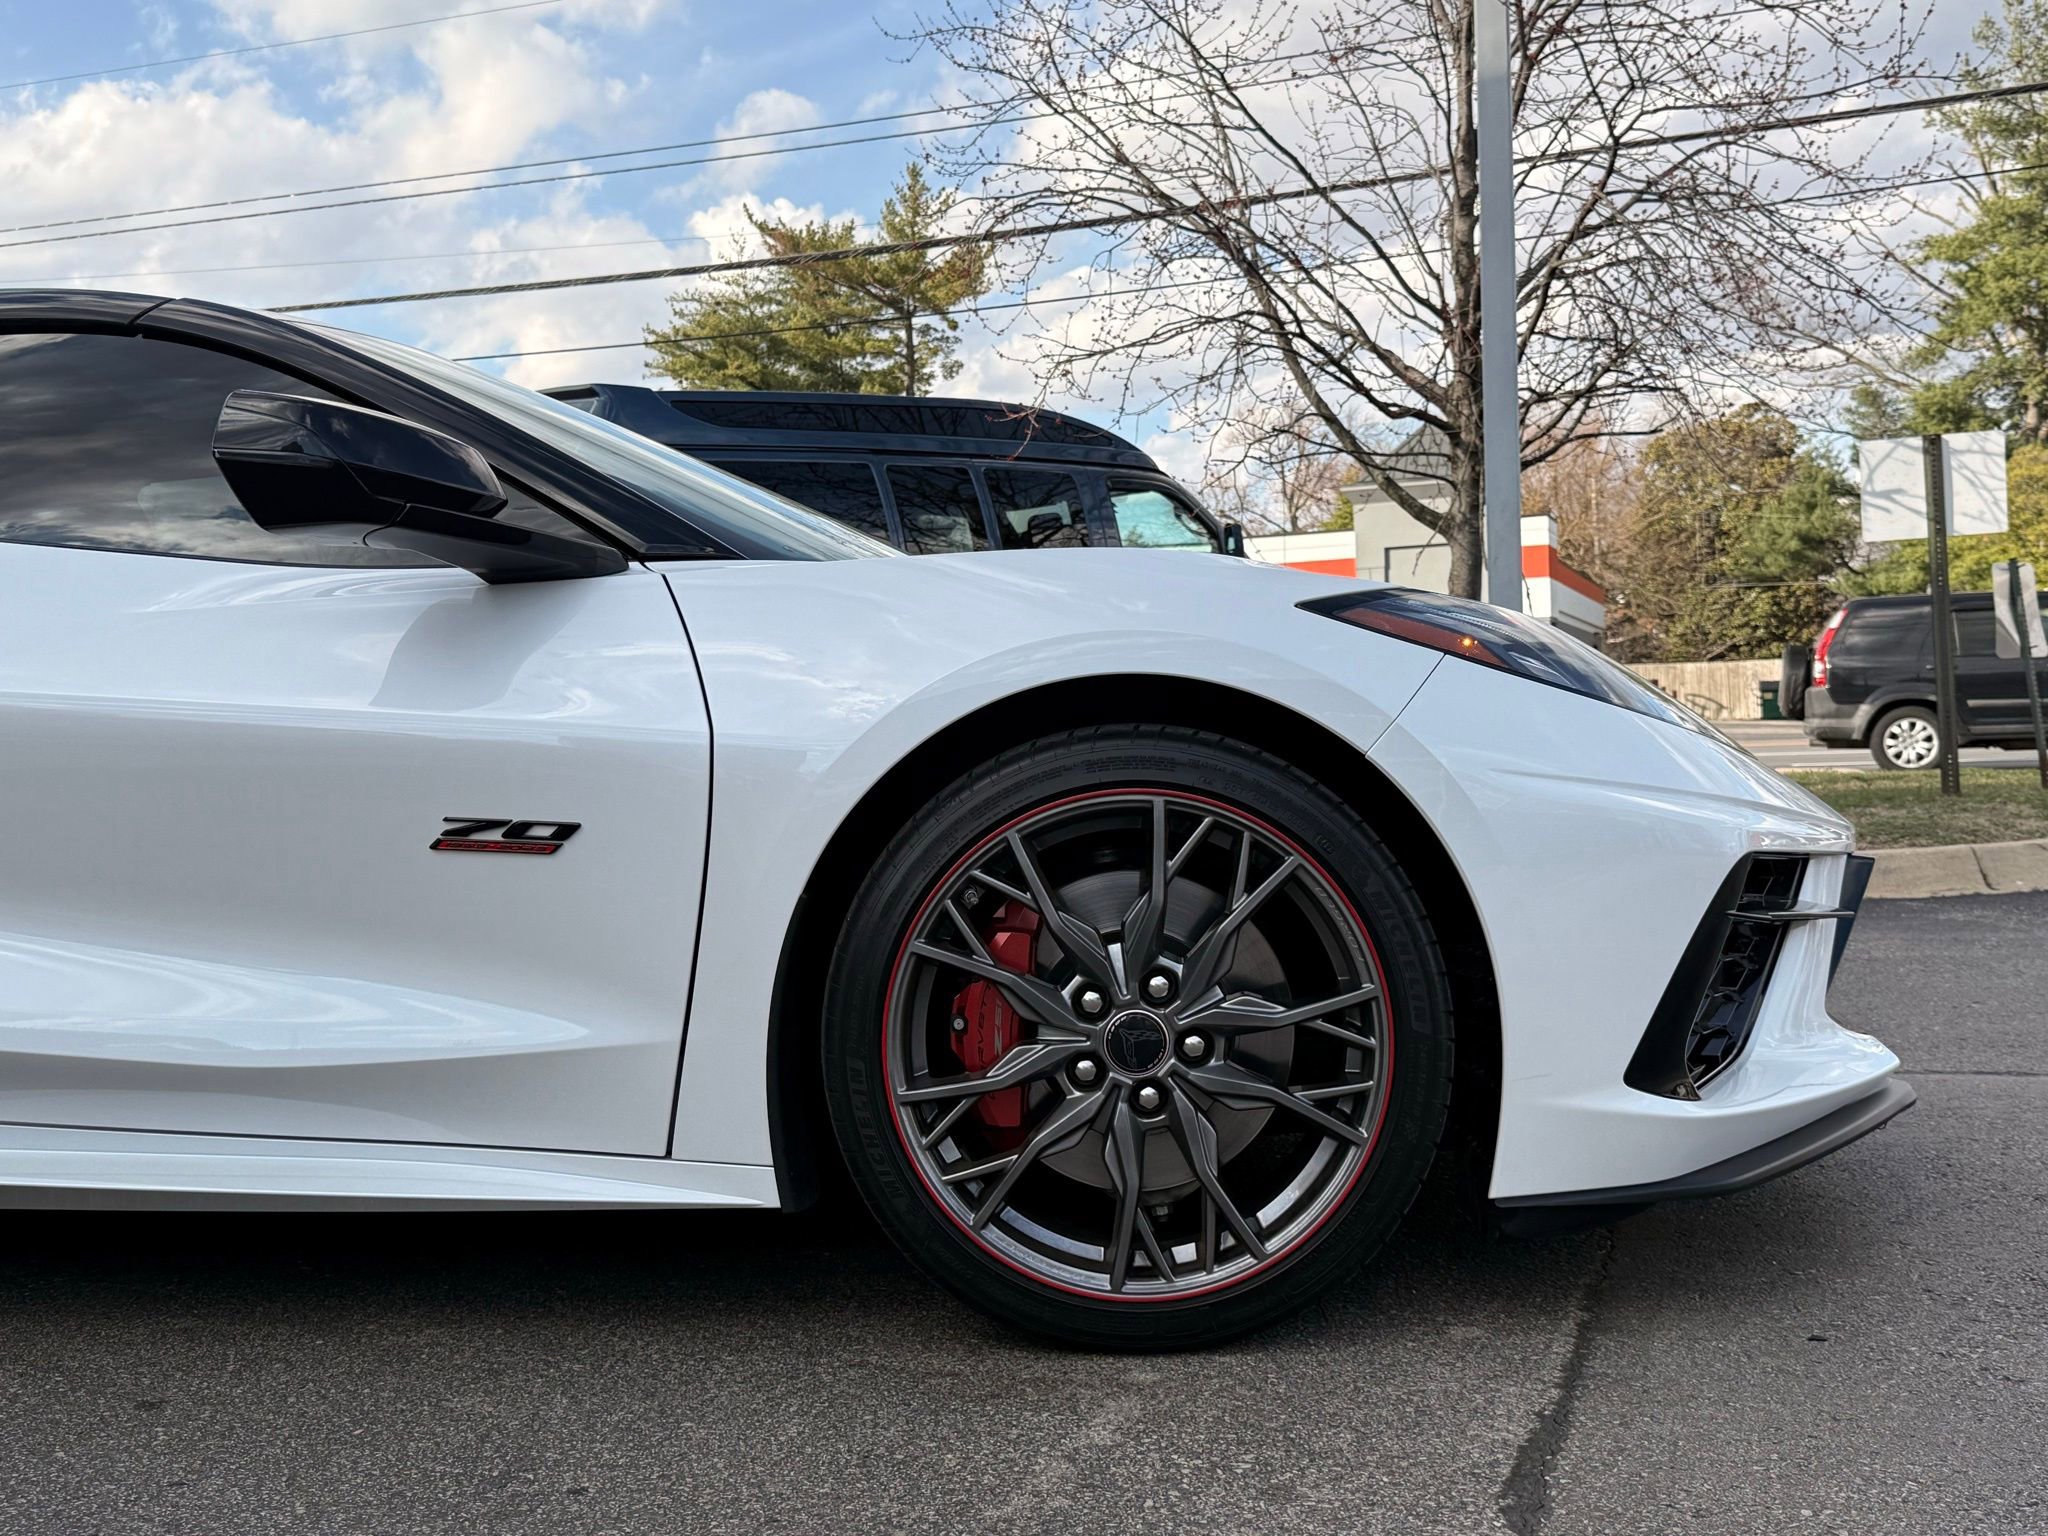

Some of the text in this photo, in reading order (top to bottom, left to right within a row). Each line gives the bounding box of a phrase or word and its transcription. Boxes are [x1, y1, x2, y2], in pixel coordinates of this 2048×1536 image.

[440, 816, 582, 841] 70
[1370, 889, 1428, 1024] MICHELIN
[848, 1065, 907, 1200] MICHELIN
